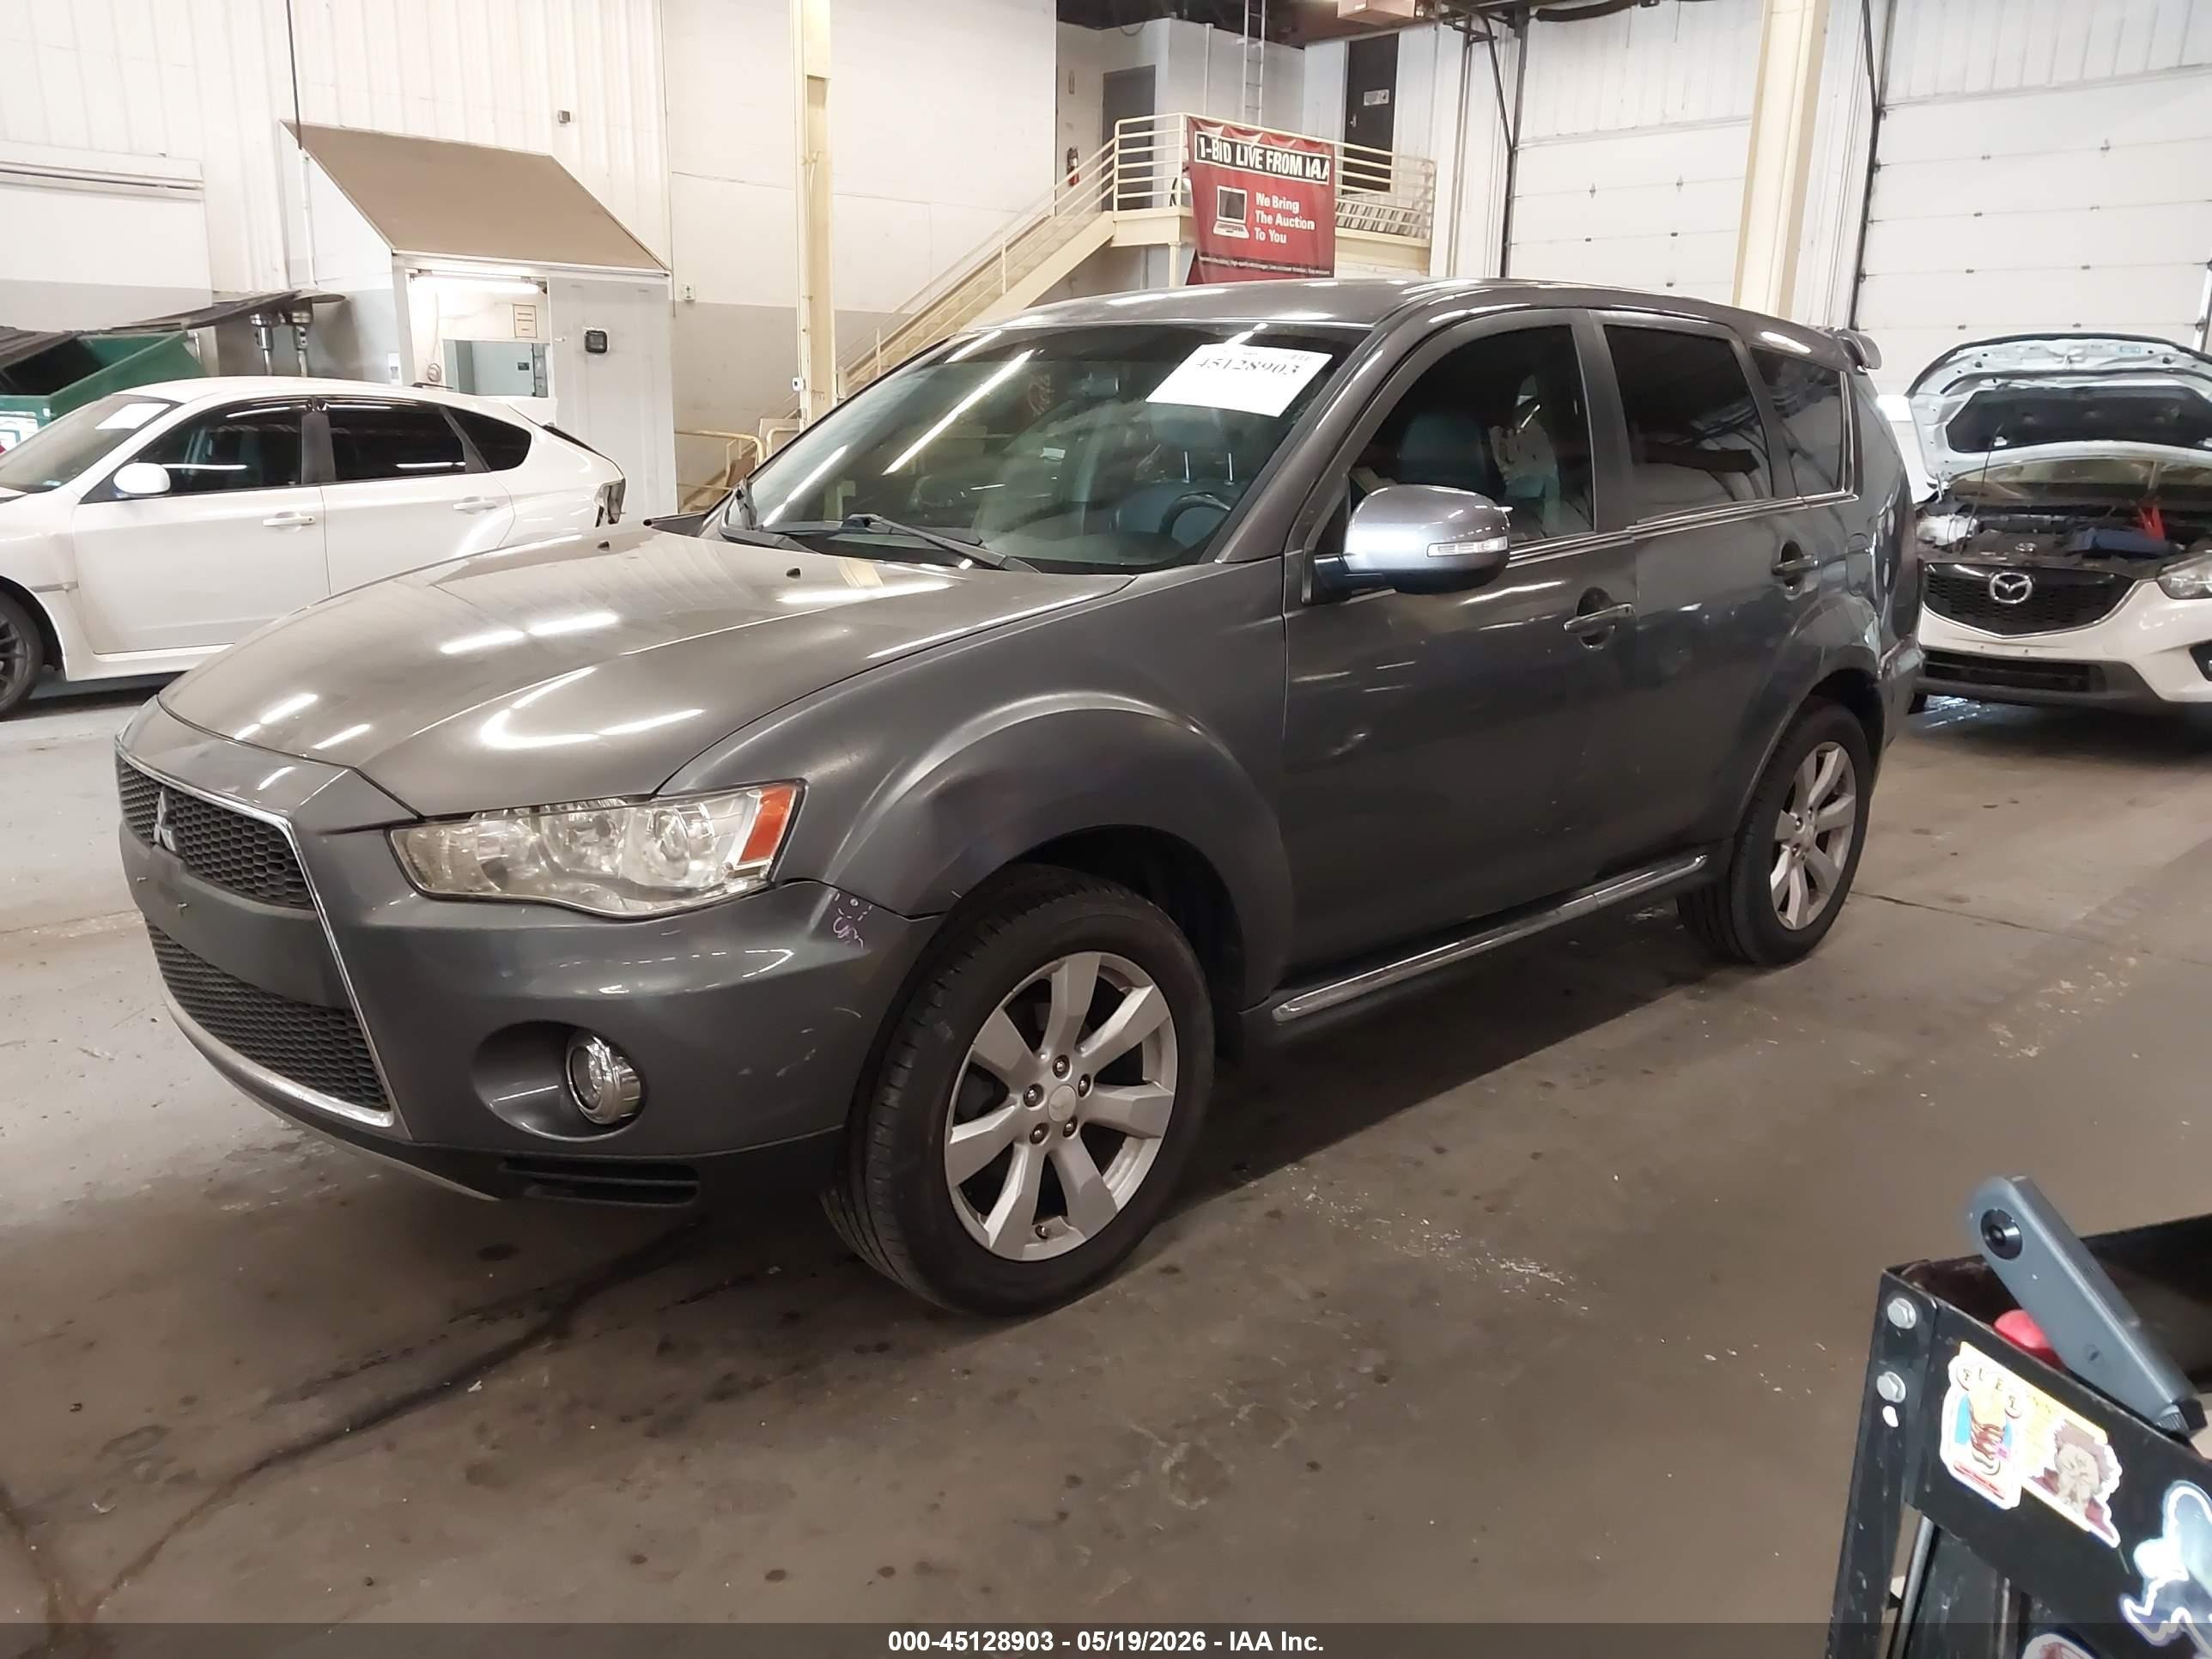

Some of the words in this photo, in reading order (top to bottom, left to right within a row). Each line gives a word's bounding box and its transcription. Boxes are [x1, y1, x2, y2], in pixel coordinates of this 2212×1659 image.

[1236, 143, 1265, 169] LIVE
[1266, 149, 1303, 177] FROM
[1305, 156, 1330, 180] IAA
[1255, 191, 1271, 208] We
[1272, 194, 1300, 215] Bring
[1255, 209, 1273, 225] The
[1274, 212, 1316, 231] Auction
[1254, 227, 1267, 241] To
[1267, 228, 1287, 244] You
